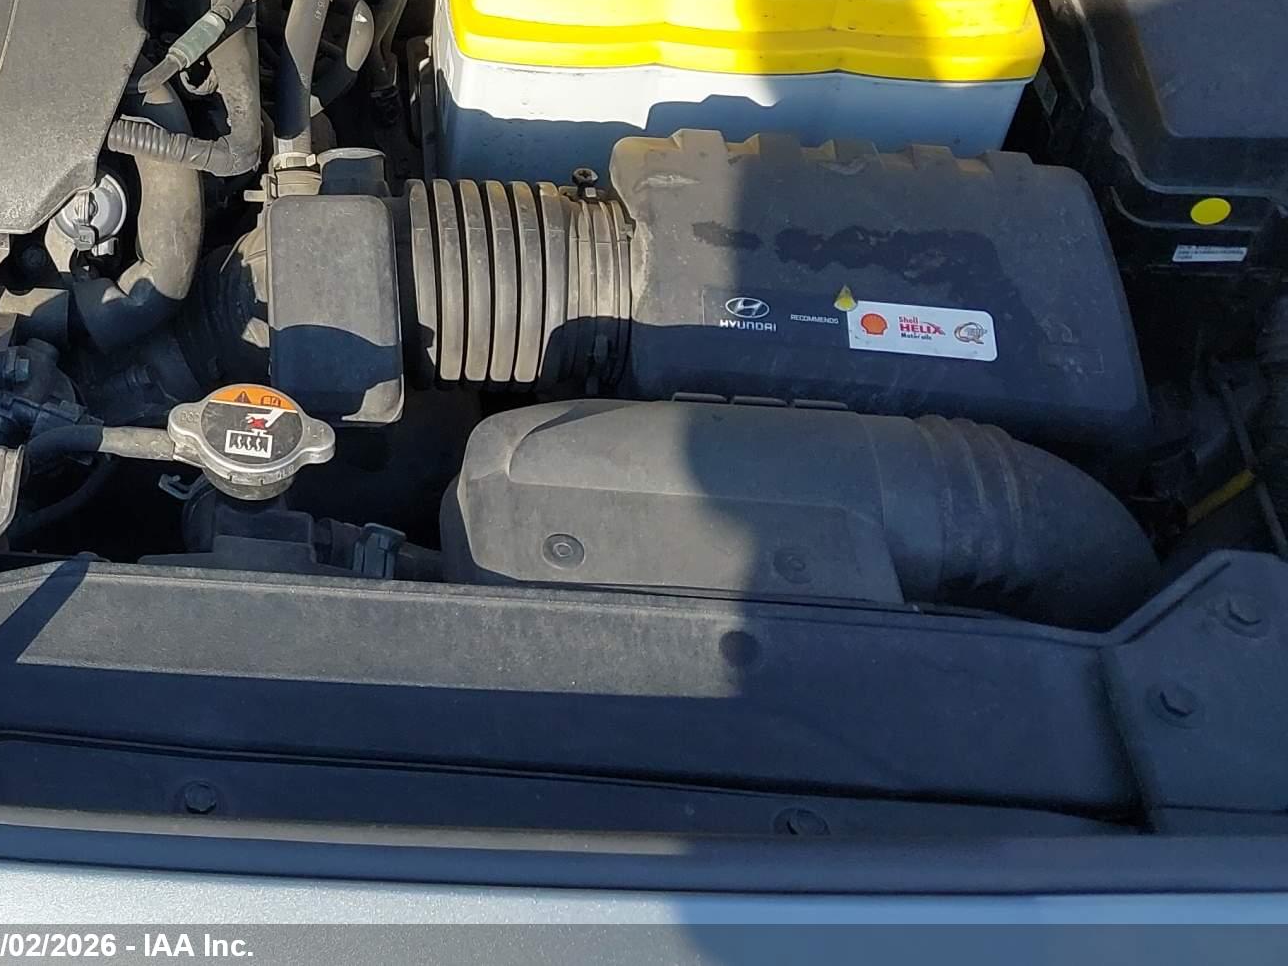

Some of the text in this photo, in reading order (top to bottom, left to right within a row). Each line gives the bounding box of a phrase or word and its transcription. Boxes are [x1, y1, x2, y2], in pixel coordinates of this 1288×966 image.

[790, 313, 840, 325] RECOMMENDS
[898, 315, 919, 324] Shell
[719, 319, 777, 333] HYUNDAI
[899, 323, 943, 336] HELIX
